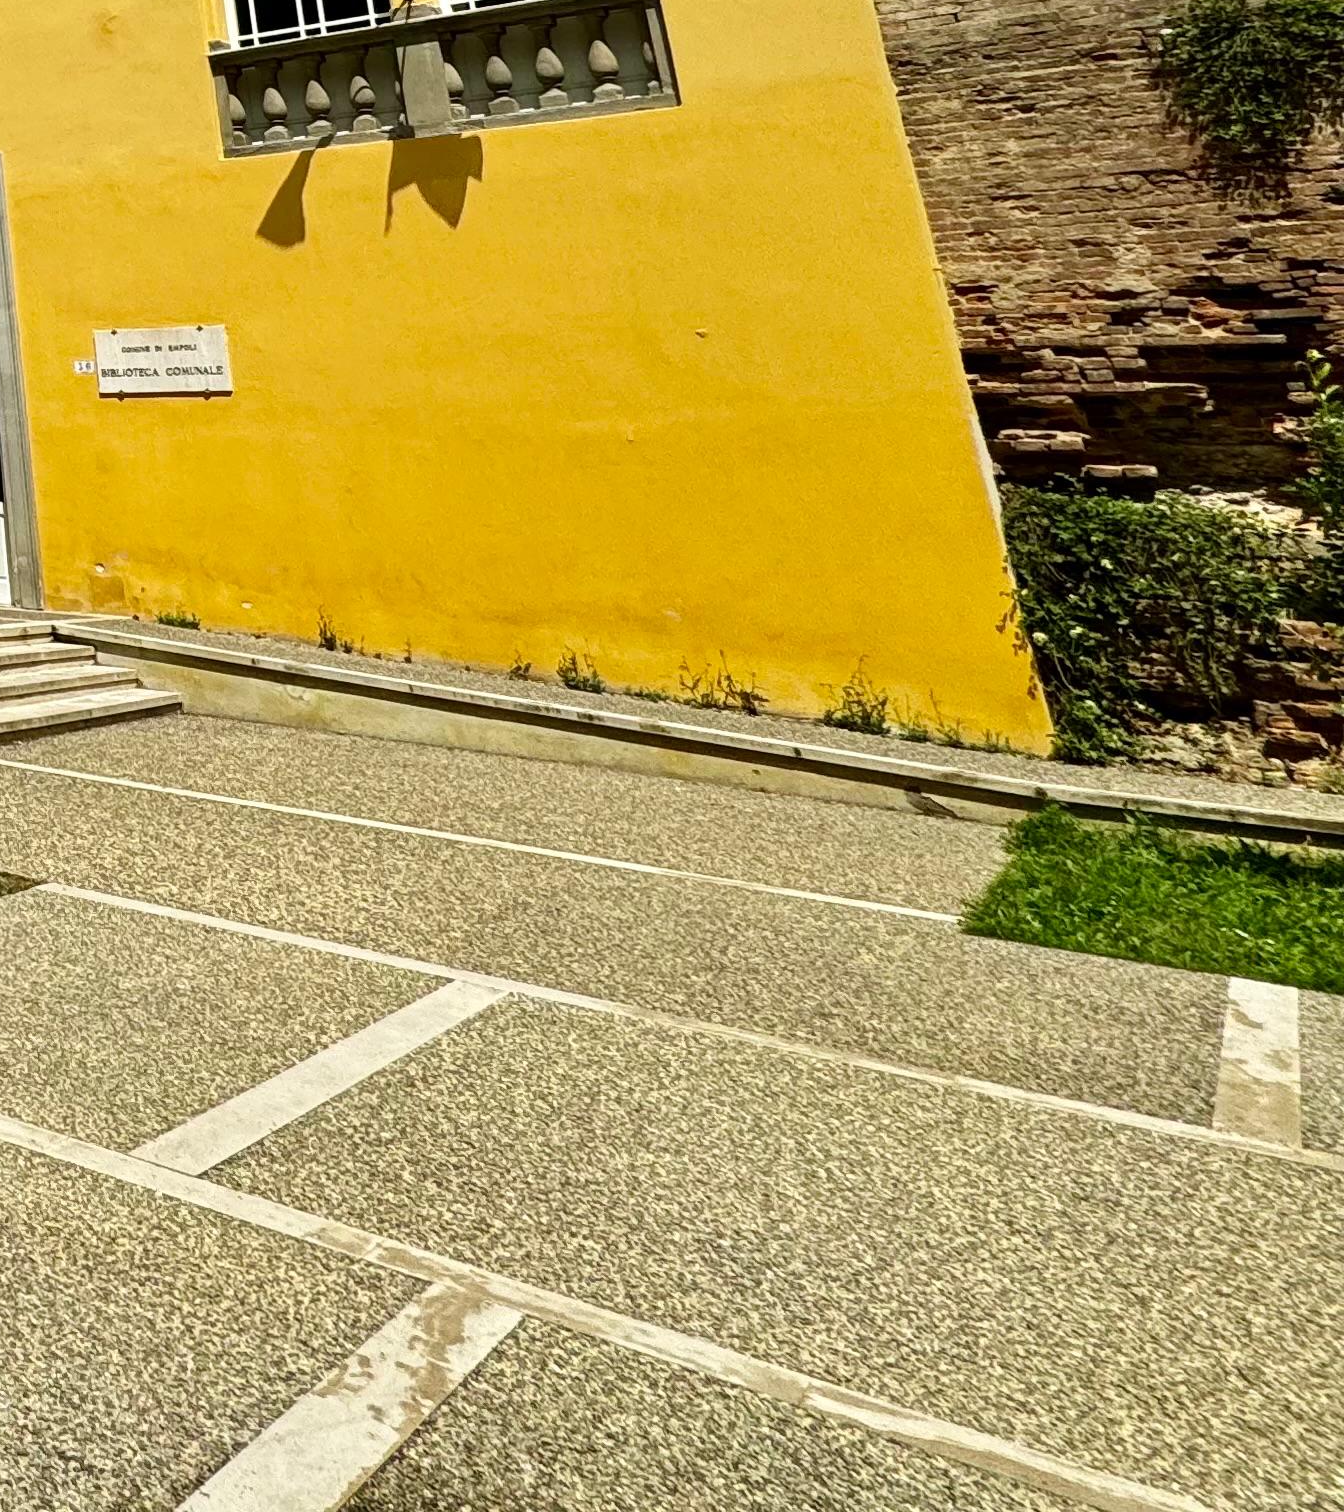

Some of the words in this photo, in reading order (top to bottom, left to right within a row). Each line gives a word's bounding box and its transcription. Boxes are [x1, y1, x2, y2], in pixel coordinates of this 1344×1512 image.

[168, 343, 197, 352] EMPOLI
[100, 367, 160, 378] BIBLIOTECA
[165, 365, 224, 376] COMUNALE
